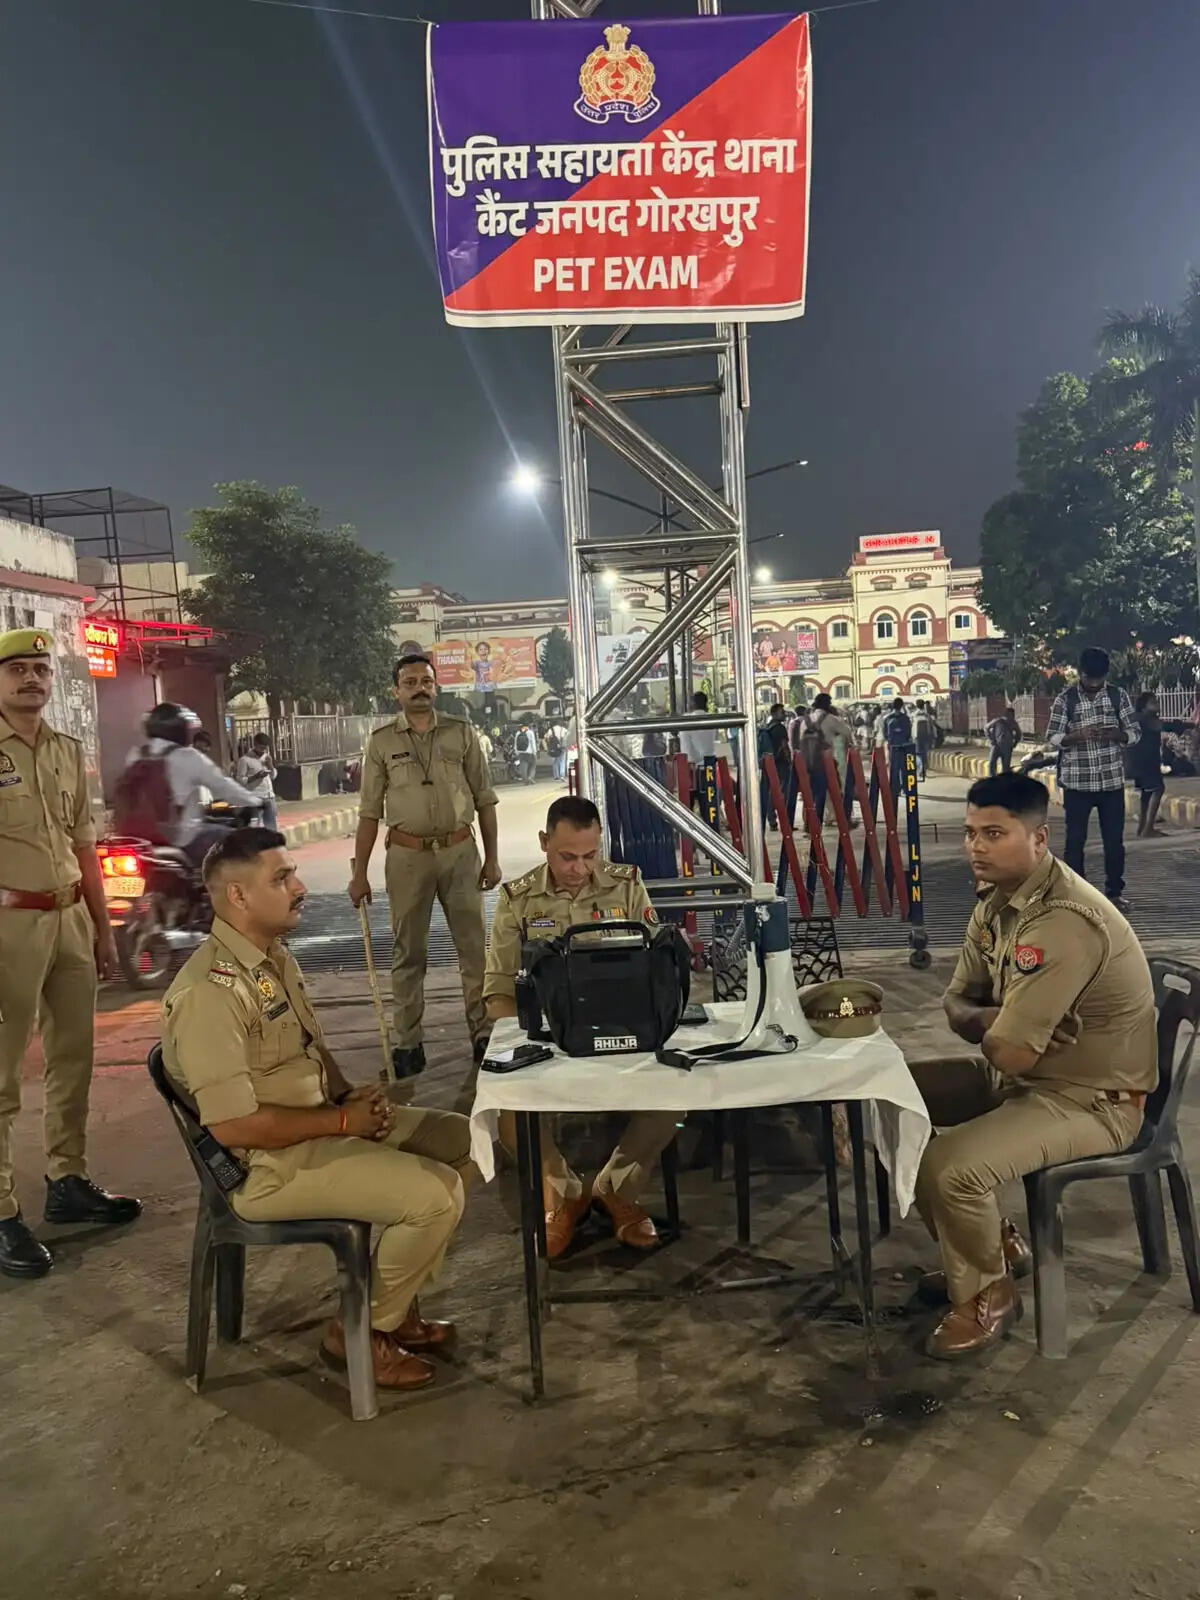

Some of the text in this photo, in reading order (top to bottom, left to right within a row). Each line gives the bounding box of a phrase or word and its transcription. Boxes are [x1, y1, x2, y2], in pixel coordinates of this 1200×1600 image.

[440, 129, 797, 197] पुलिस सहायता केंद्र थाना
[475, 186, 760, 247] कैंट जनपद गोरखपुर
[534, 255, 698, 292] PET EXAM
[906, 754, 921, 902] RPF LJN
[594, 1038, 638, 1049] AHUJA
